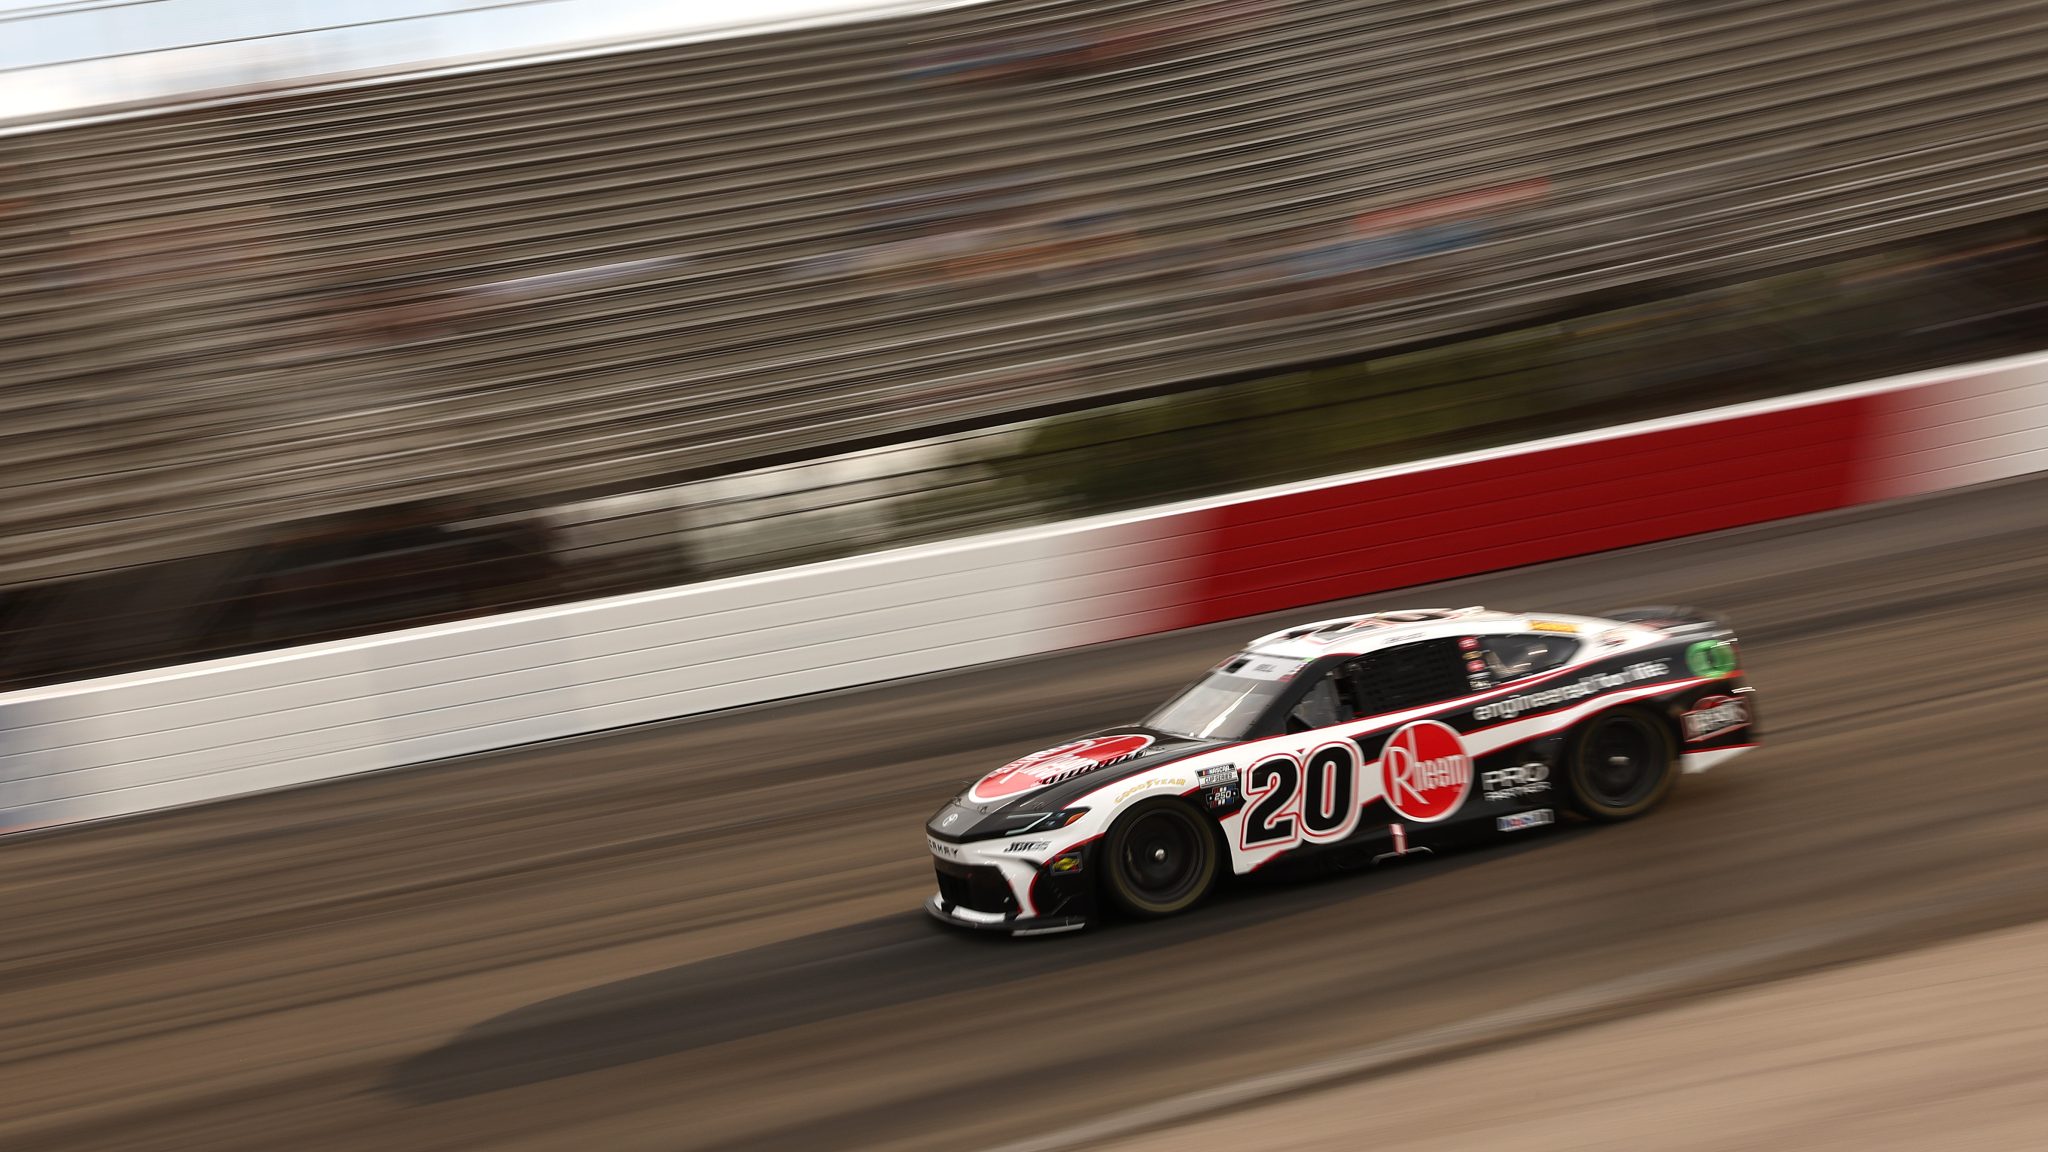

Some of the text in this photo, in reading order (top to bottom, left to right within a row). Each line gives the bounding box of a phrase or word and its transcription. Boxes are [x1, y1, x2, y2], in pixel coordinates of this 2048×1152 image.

[1387, 727, 1469, 806] Rheem
[1481, 762, 1549, 791] PRO
[1115, 778, 1186, 803] GOODYEAR
[1214, 790, 1232, 801] 250
[1243, 744, 1356, 847] 20
